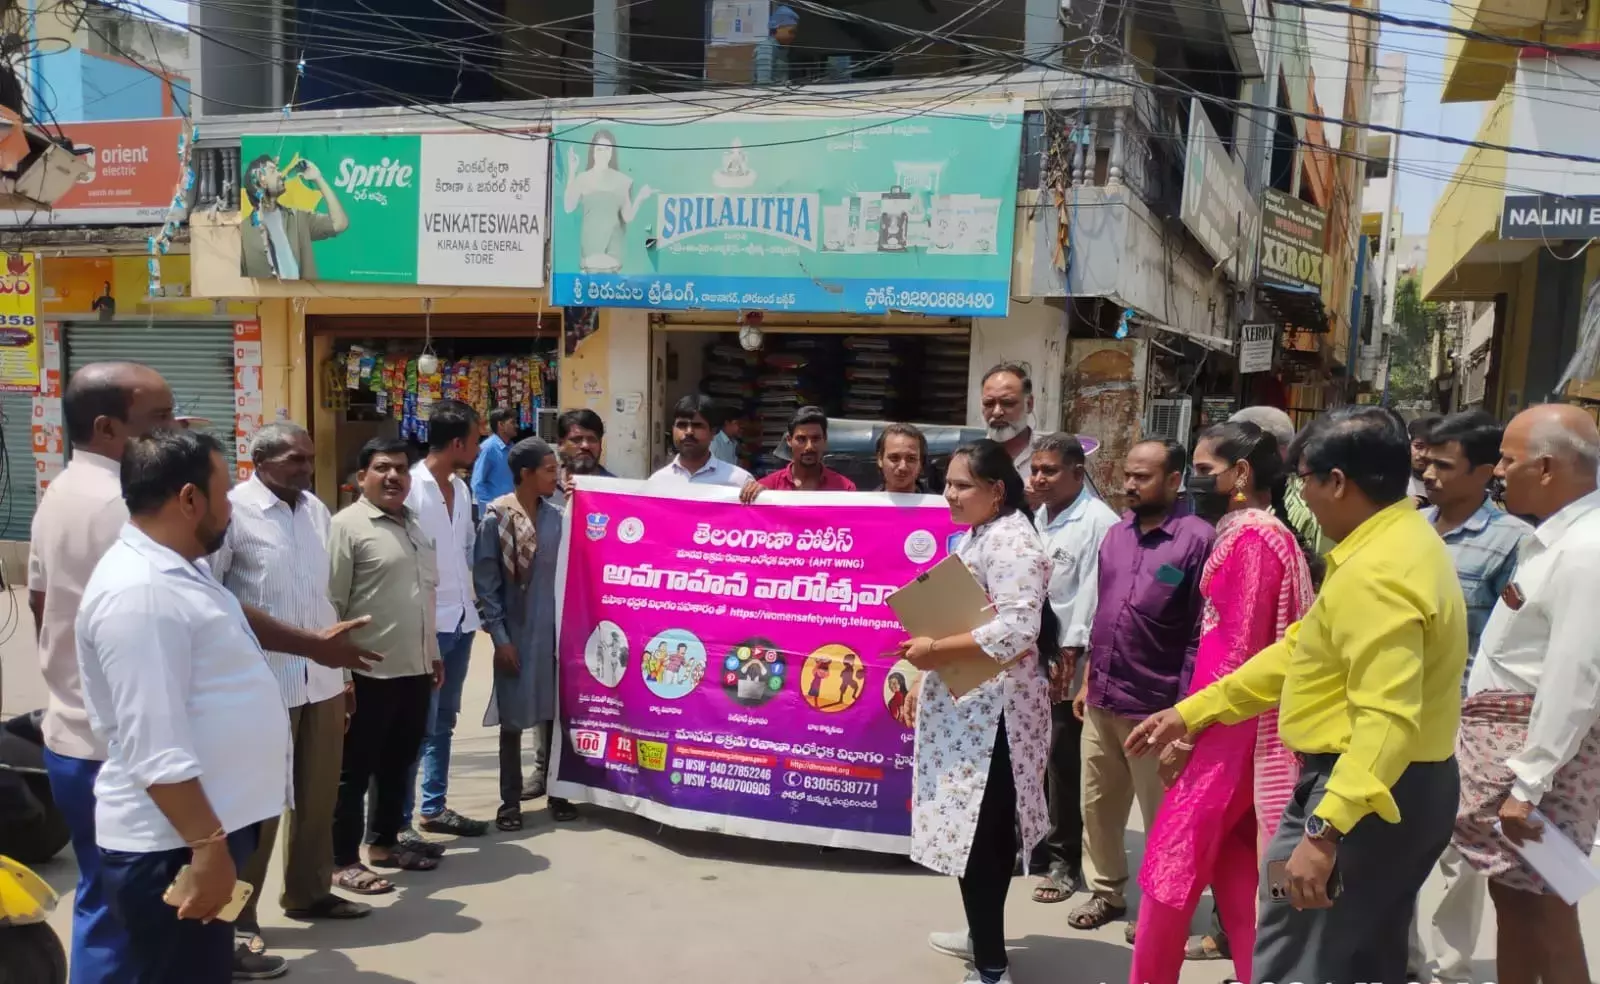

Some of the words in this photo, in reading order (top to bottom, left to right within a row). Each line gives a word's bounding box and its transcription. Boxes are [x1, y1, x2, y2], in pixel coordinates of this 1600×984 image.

[101, 144, 149, 163] orient
[102, 165, 137, 177] electric
[335, 157, 411, 194] Sprite
[476, 178, 507, 193] జనరల్
[424, 212, 540, 235] VENKATESWARA
[662, 196, 812, 242] SRILALITHA
[1509, 207, 1583, 226] NALINI
[437, 239, 471, 251] KIRANA
[473, 240, 479, 251] &
[481, 240, 524, 252] GENERAL
[464, 253, 494, 264] STORE
[1261, 236, 1323, 285] XEROX
[587, 281, 643, 301] తిరుమల
[1245, 325, 1273, 342] XEROX
[692, 522, 793, 551] తెలంగాణా
[796, 526, 854, 553] పోలీస్
[809, 558, 832, 568] (AHT
[834, 558, 865, 570] WING)
[603, 563, 749, 597] అవగాహన
[753, 571, 901, 613] వారోత్సవా
[576, 737, 599, 751] 100
[675, 728, 713, 743] మానవ
[715, 734, 748, 749] అక్రమ
[749, 737, 791, 752] రవాణా
[791, 742, 836, 759] నిరోధక
[836, 748, 885, 764] విభాగం
[728, 763, 772, 781] 27852246
[803, 775, 878, 796] 6305538771
